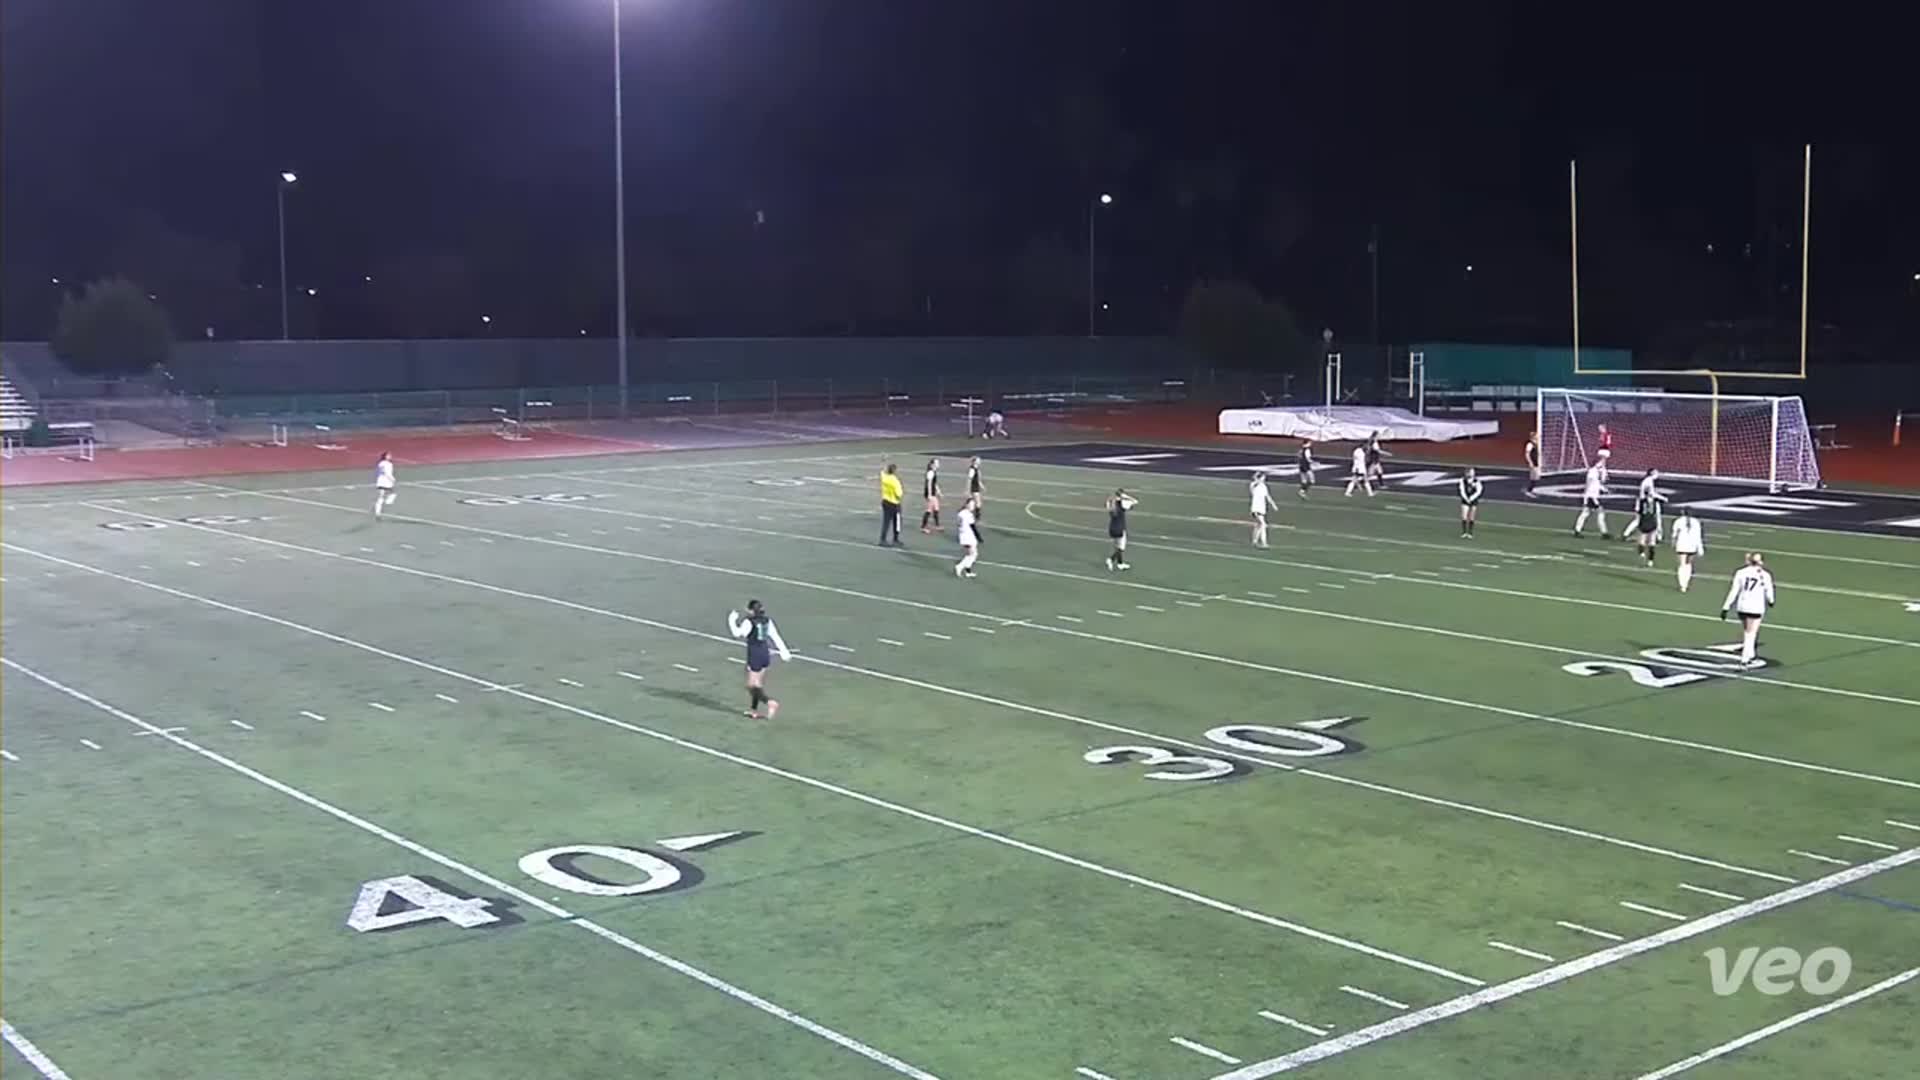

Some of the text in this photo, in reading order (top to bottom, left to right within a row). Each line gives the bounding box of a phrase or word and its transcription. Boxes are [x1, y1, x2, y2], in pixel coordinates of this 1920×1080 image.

[1080, 452, 1920, 528] LANCE
[1743, 576, 1759, 591] 17
[1561, 647, 1767, 688] 20
[1083, 724, 1346, 781] 30
[346, 844, 685, 933] 40
